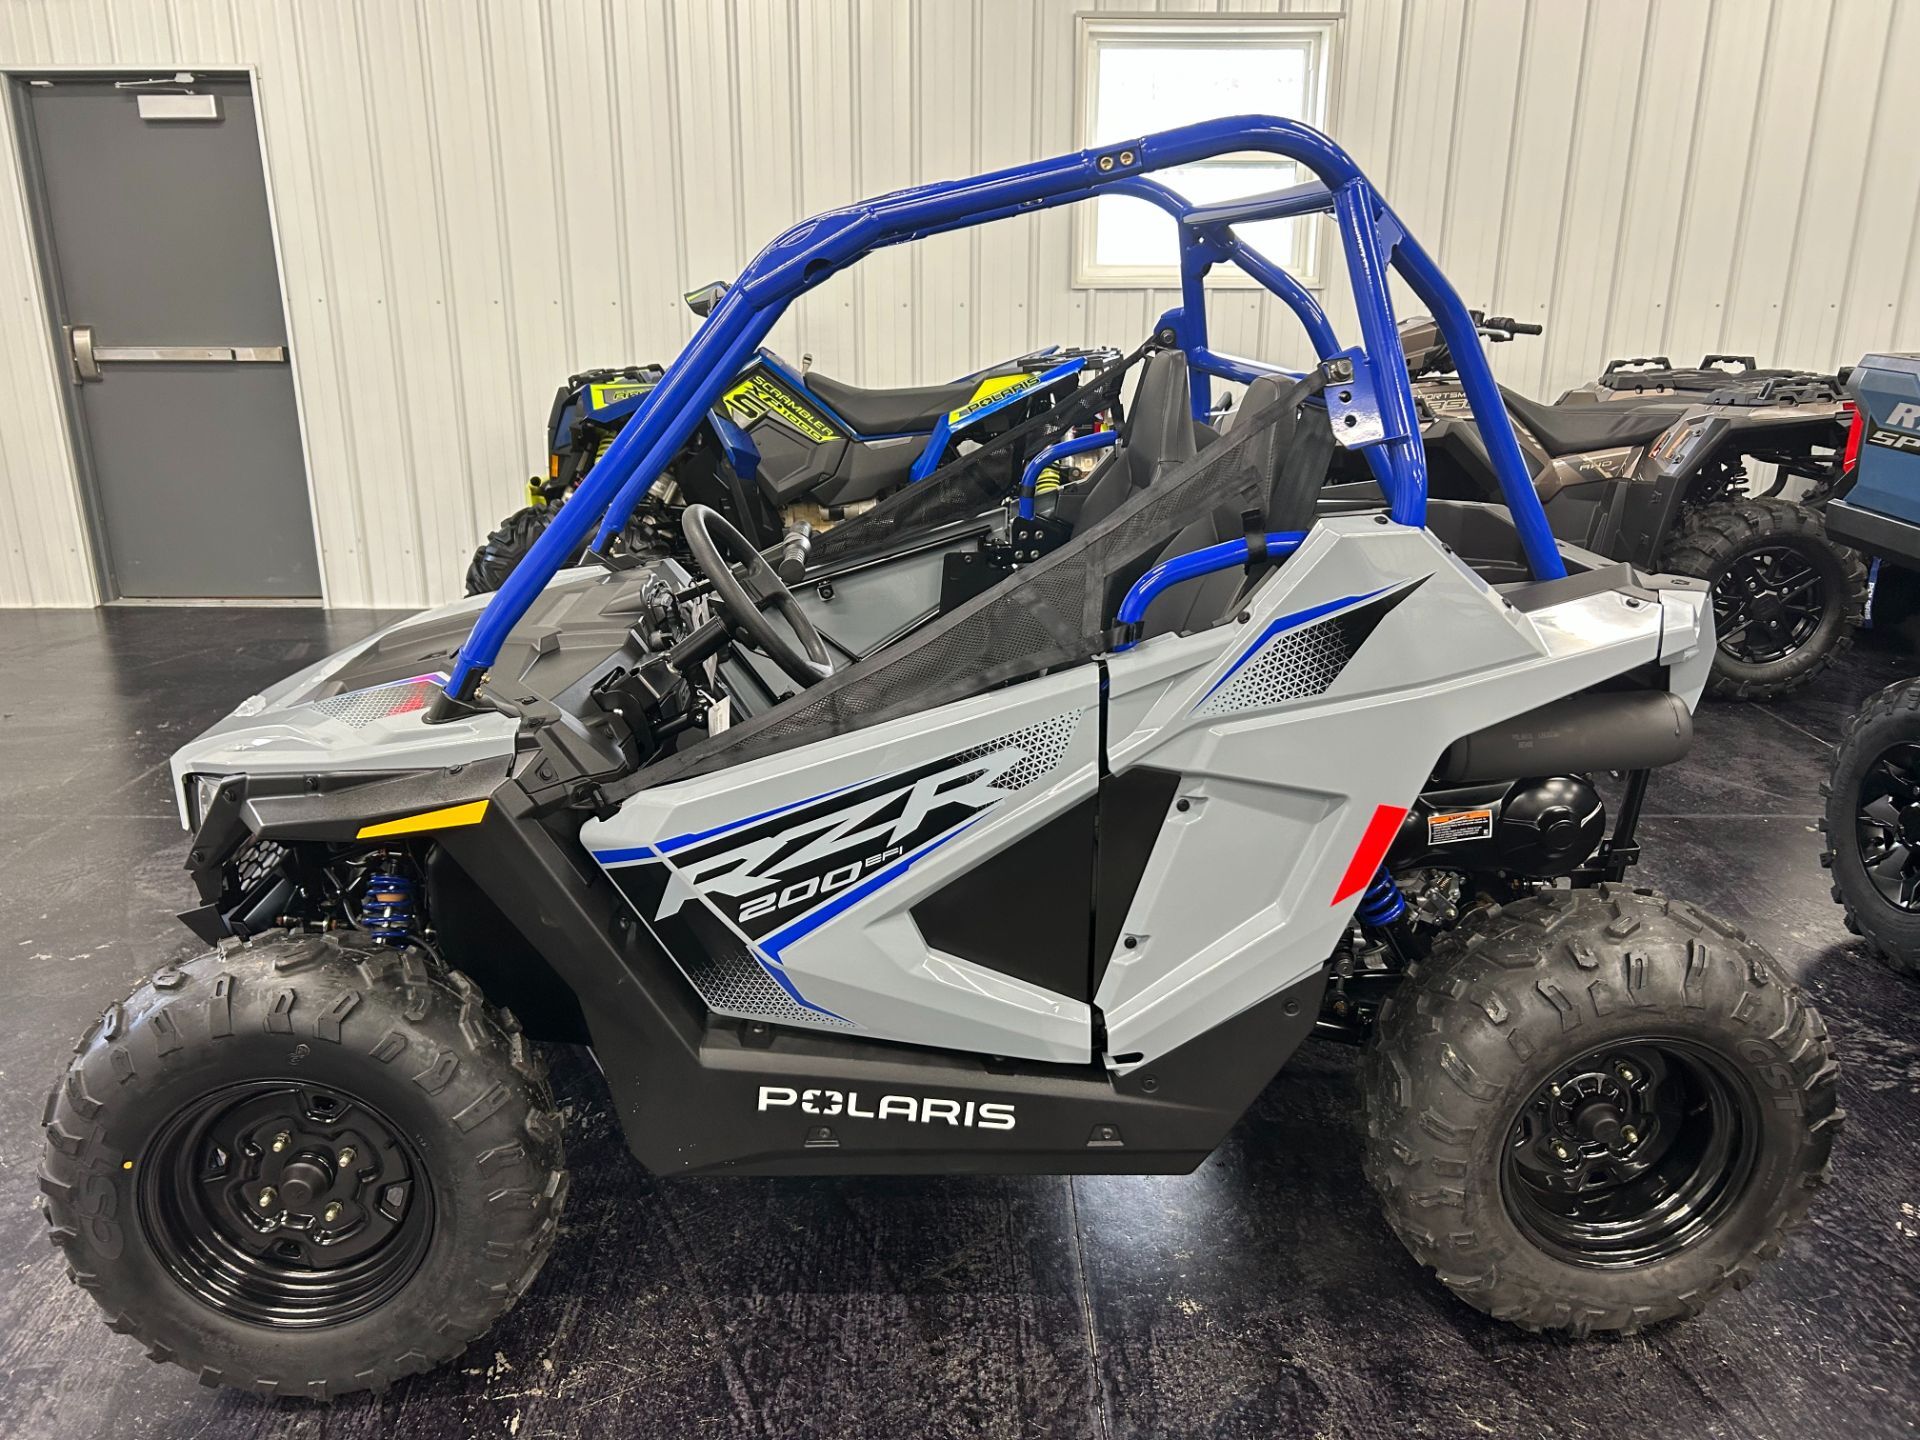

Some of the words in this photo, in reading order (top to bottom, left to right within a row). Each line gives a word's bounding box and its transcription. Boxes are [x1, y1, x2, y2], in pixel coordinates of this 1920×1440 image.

[753, 376, 834, 436] SCRAMBLER
[967, 376, 1040, 413] POLARIS
[1885, 402, 1920, 429] R
[654, 746, 1029, 922] RZR
[738, 861, 863, 923] 200
[865, 846, 903, 868] EFI
[758, 1086, 1016, 1131] POLARIS
[1738, 1040, 1804, 1118] CST
[79, 1125, 124, 1261] CST
